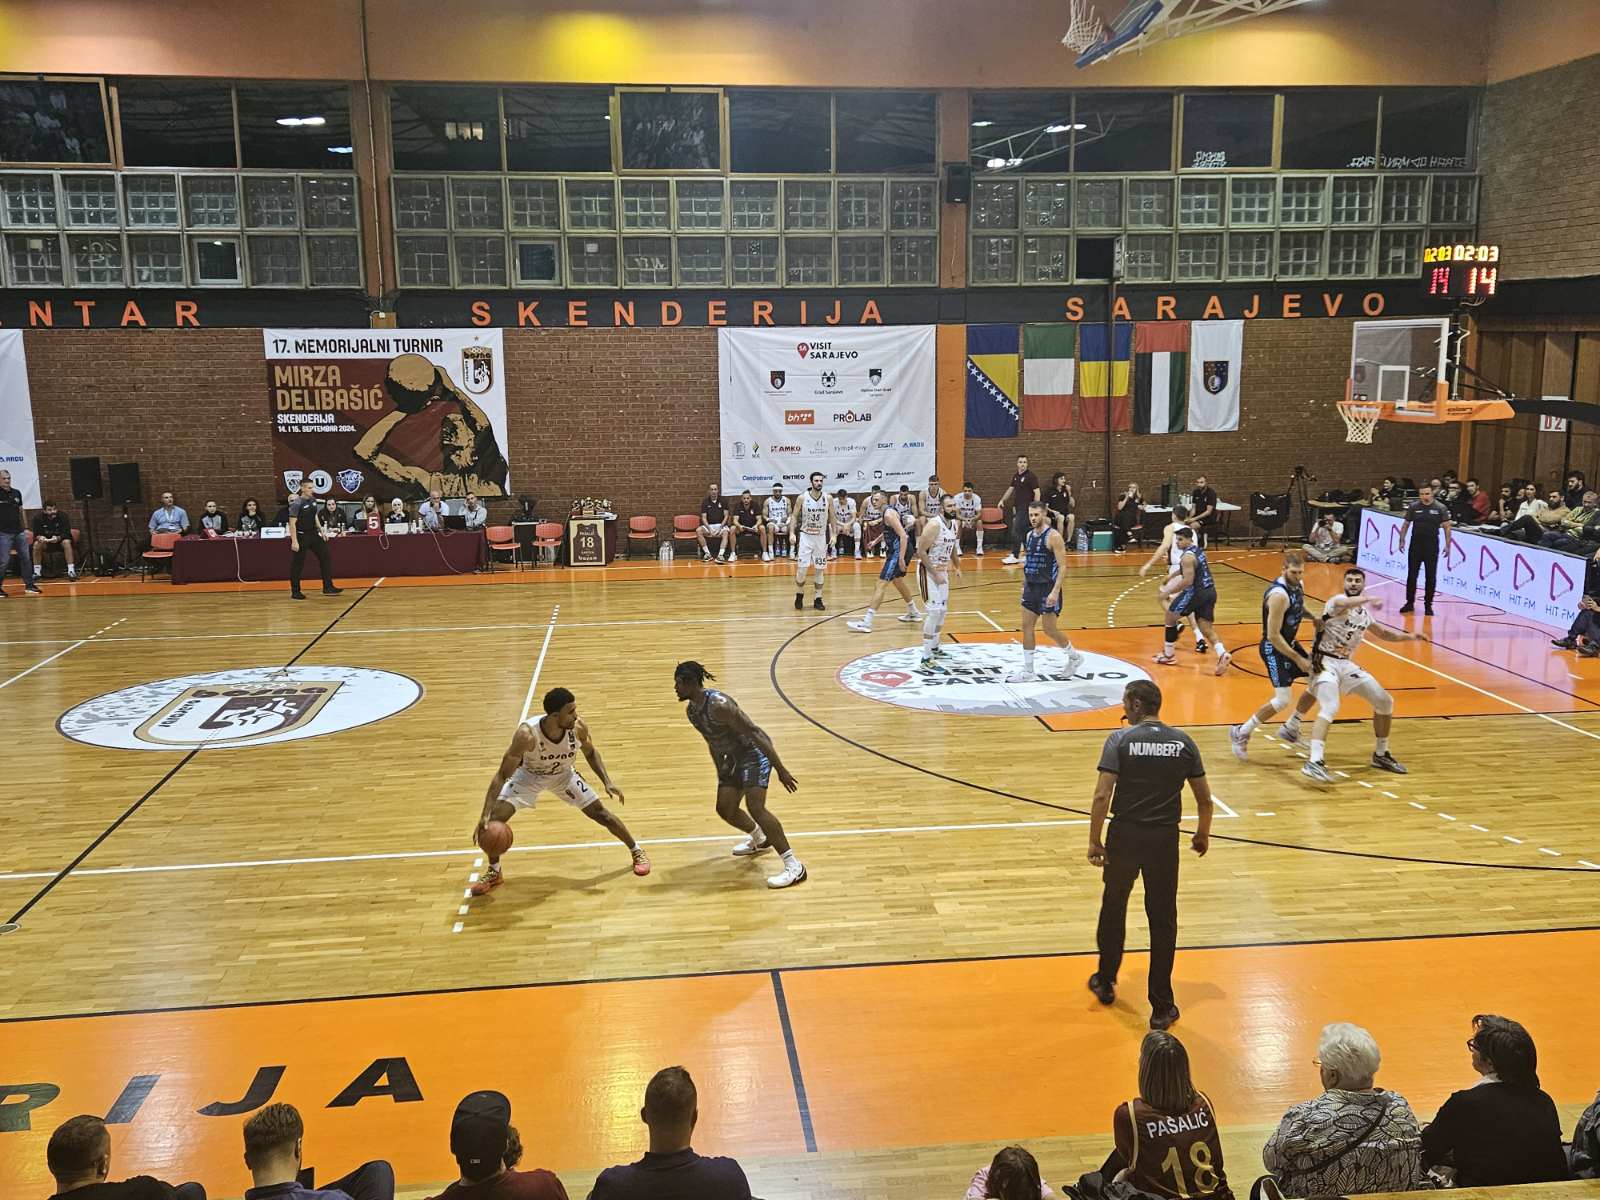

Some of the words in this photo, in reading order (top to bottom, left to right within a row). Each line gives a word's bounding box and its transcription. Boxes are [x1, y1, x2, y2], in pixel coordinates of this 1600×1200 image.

[1453, 245, 1499, 261] 02:03
[1468, 267, 1497, 294] 14
[0, 300, 200, 327] NTAR
[471, 300, 883, 327] SKENDERIJA
[1066, 292, 1385, 321] SARAJEVO
[273, 339, 291, 354] 17.
[294, 338, 391, 354] MEMORIJALNI
[395, 338, 444, 353] TURNIR
[810, 342, 832, 350] VISIT
[810, 351, 858, 359] SARAJEVO
[274, 365, 341, 387] MIRZA
[277, 384, 383, 411] DELIBAŠIĆ
[277, 413, 335, 424] SKENDERIJA
[833, 411, 872, 423] PROLAB
[339, 424, 357, 432] 2024.
[368, 516, 379, 529] 5
[580, 536, 595, 548] 18
[1475, 584, 1487, 594] HIT
[1489, 588, 1501, 600] FM
[1509, 593, 1522, 606] HIT
[1524, 597, 1536, 610] FM
[1545, 604, 1559, 617] HIT
[1561, 608, 1575, 620] FM
[921, 671, 1129, 687] SARJEVO
[191, 687, 328, 698] bosna
[576, 780, 588, 793] 2
[1145, 1108, 1209, 1139] PAŠALIĆ
[1161, 1141, 1219, 1199] 18
